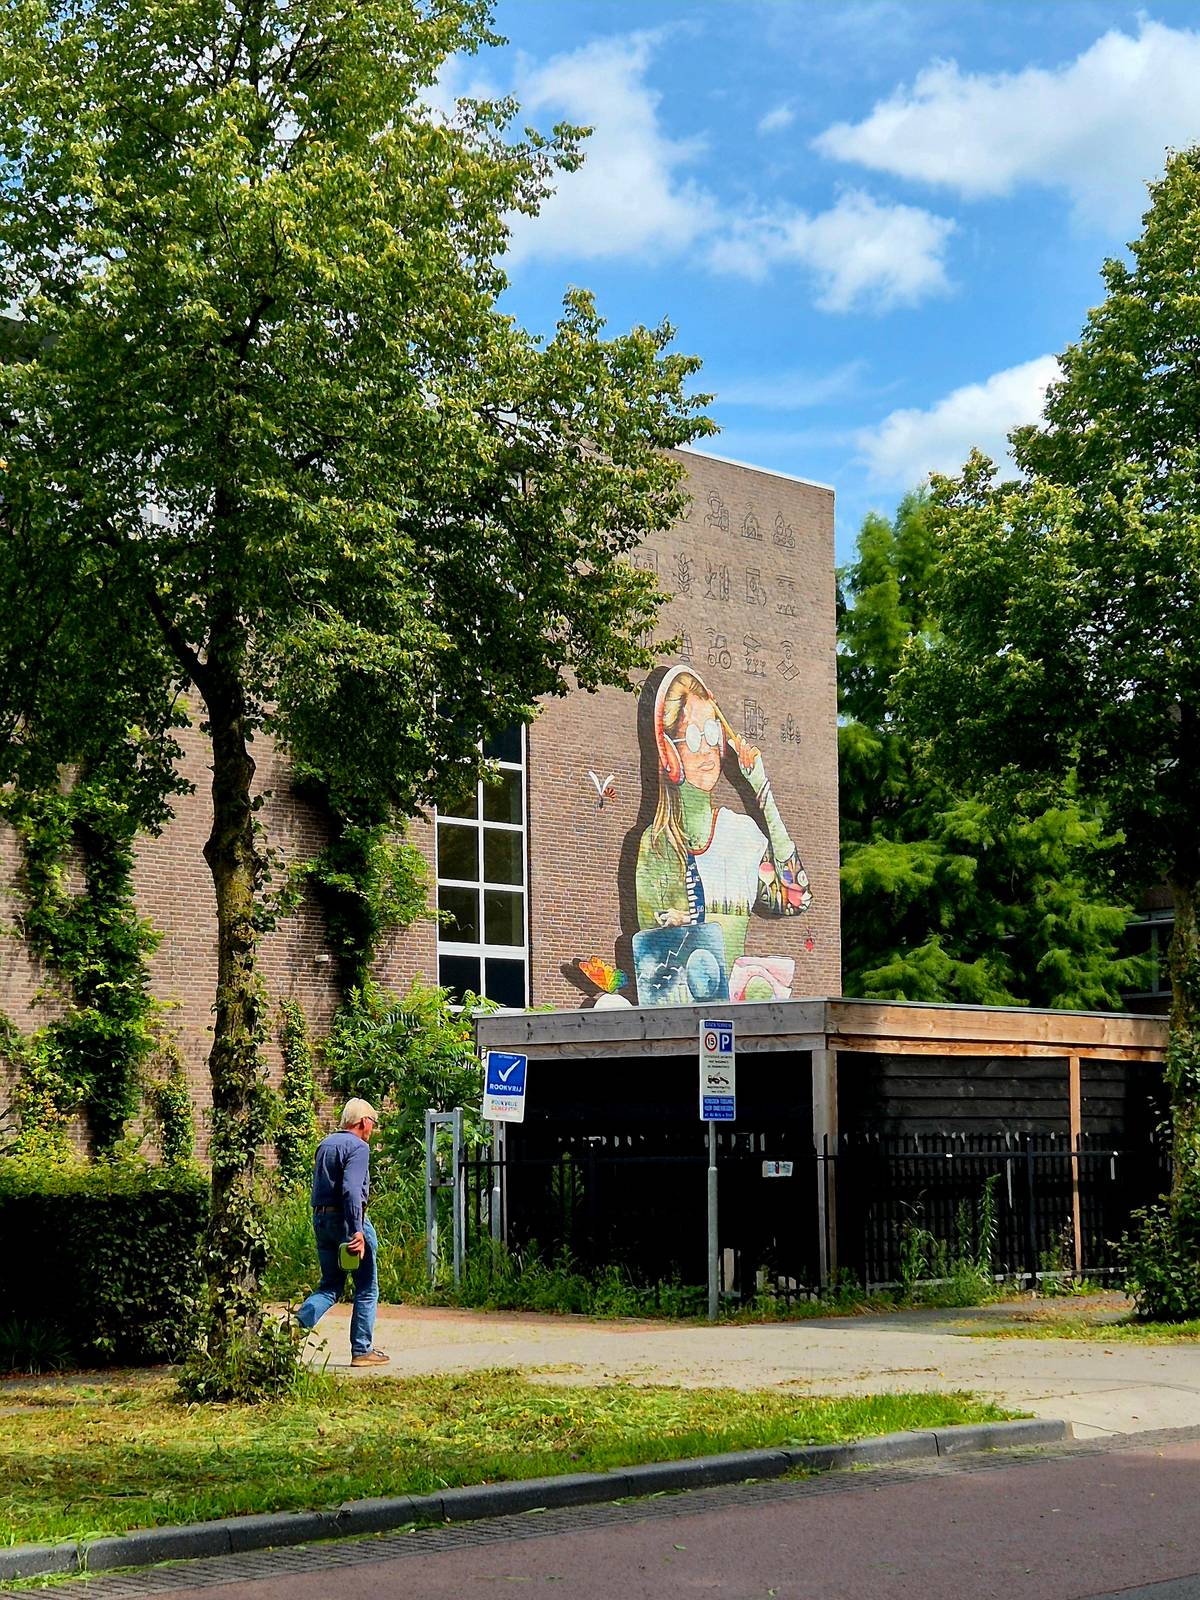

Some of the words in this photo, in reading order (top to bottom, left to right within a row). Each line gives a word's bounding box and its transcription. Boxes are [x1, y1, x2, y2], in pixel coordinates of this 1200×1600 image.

[708, 1037, 715, 1045] 15
[722, 1035, 730, 1049] P
[490, 1083, 522, 1092] ROOKVRIJ
